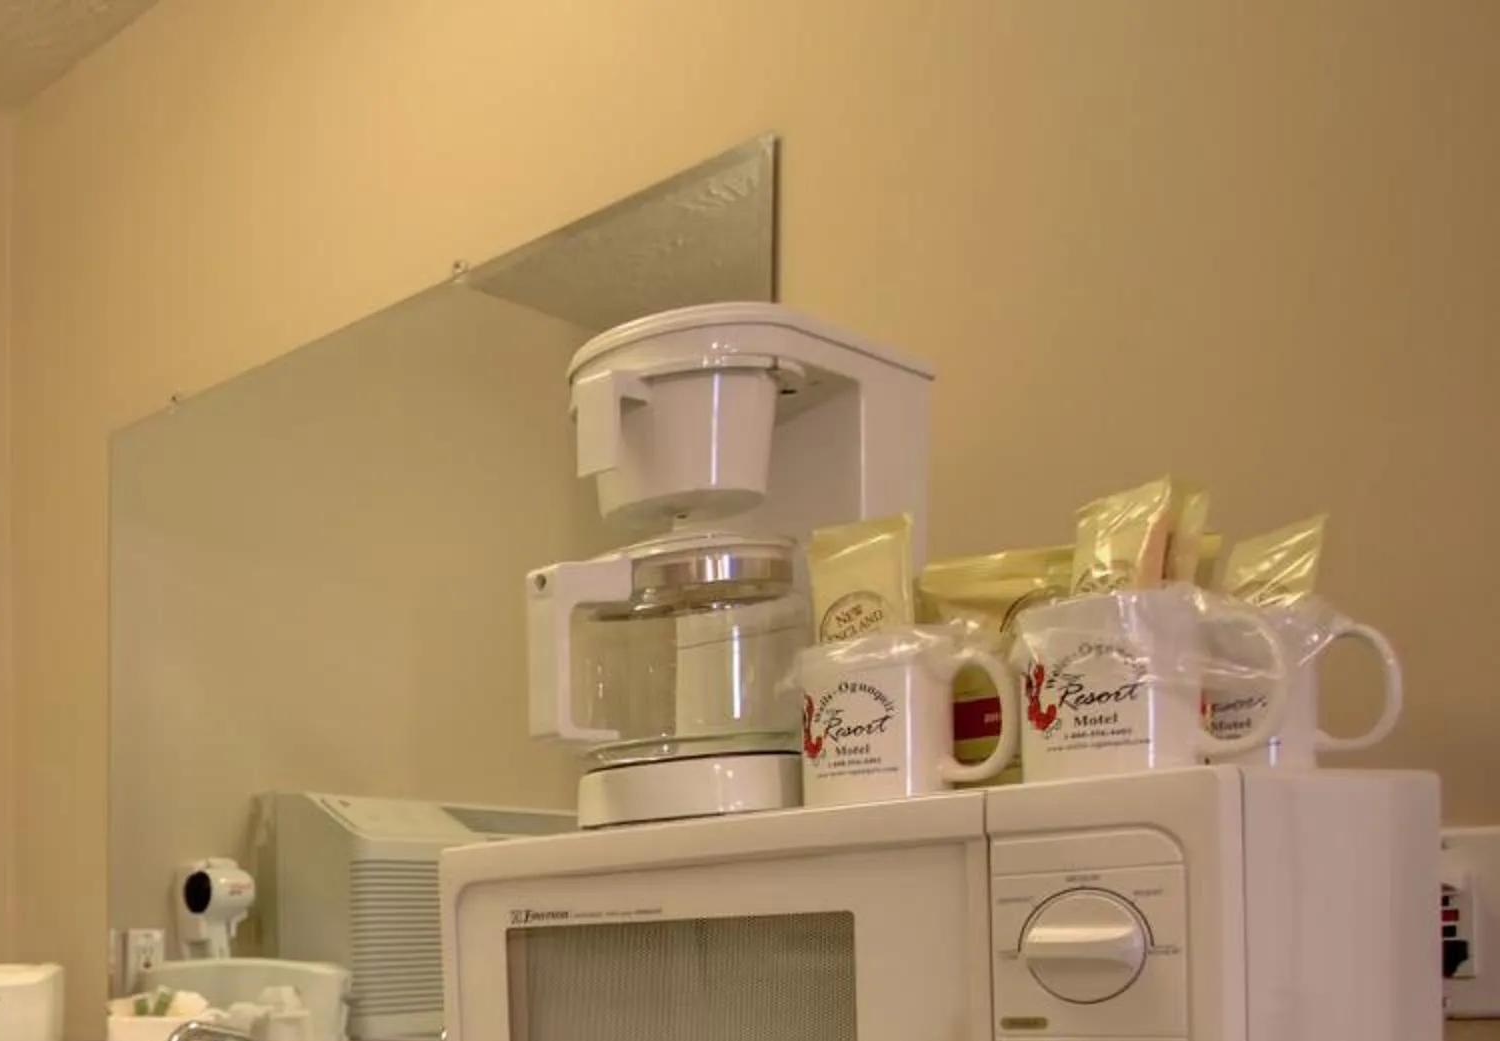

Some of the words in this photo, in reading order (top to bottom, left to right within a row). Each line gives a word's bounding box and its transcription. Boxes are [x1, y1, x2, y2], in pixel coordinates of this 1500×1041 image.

[835, 603, 863, 624] NEW
[1057, 682, 1149, 711] Resort
[822, 715, 892, 743] Resort
[1073, 712, 1119, 728] Motel
[835, 743, 871, 756] Motel
